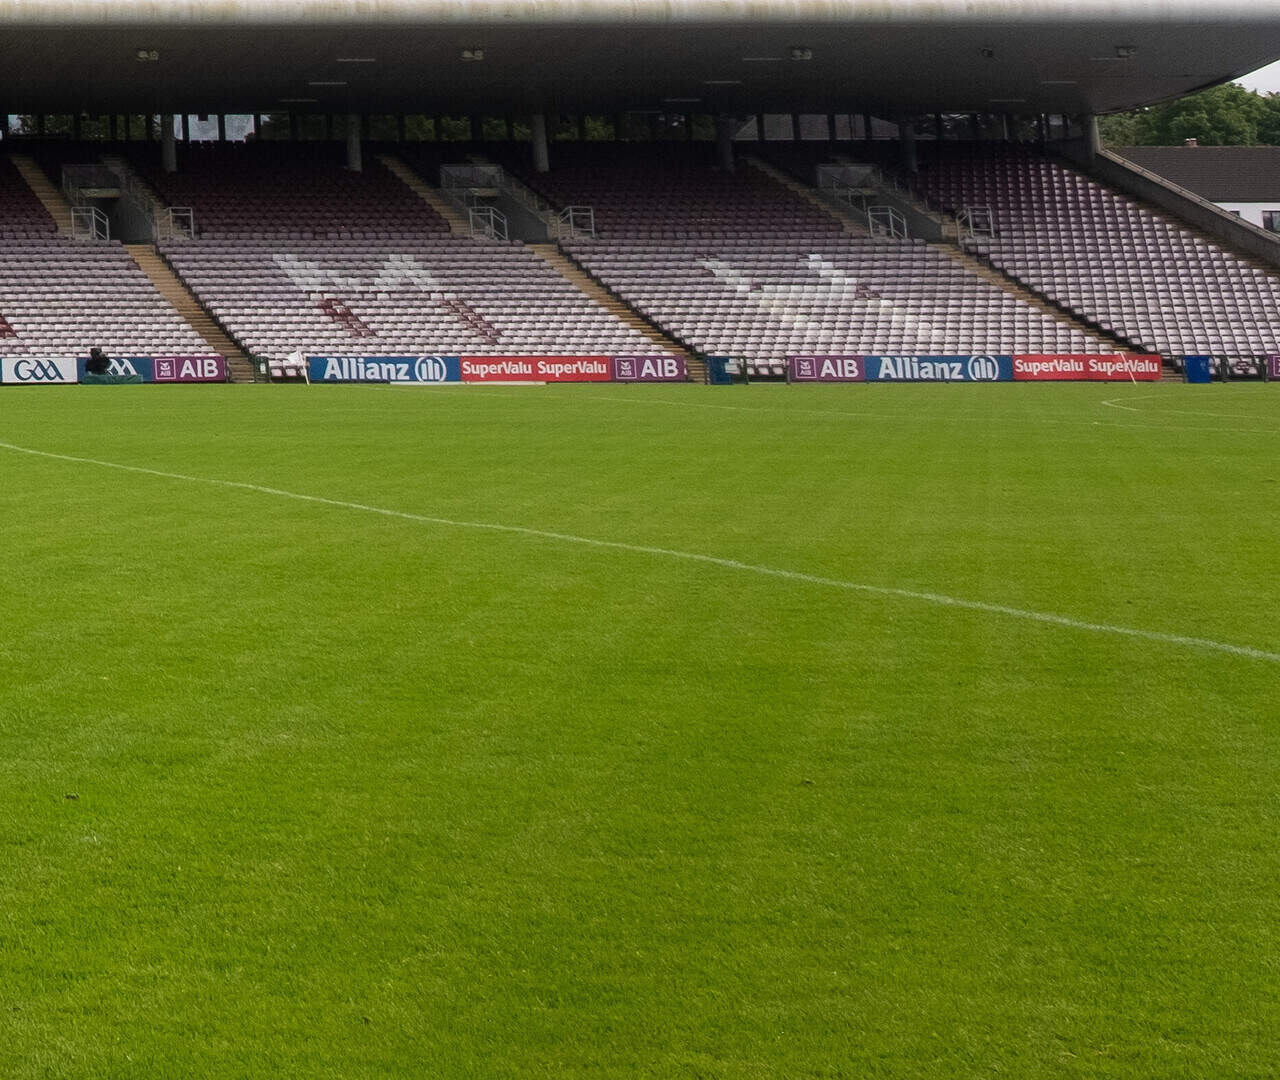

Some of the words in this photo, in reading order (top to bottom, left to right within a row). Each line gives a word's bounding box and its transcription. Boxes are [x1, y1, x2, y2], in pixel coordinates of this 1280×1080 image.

[14, 359, 64, 381] GAA
[106, 358, 138, 376] AA
[180, 359, 219, 378] AIB
[323, 357, 410, 381] Allianz
[462, 361, 532, 378] SuperValu
[537, 361, 607, 378] SuperValu
[641, 359, 679, 378] AIB
[820, 359, 859, 378] AIB
[878, 356, 964, 379] Allianz
[1014, 359, 1084, 376] SuperValu
[1089, 359, 1158, 376] SuperValu
